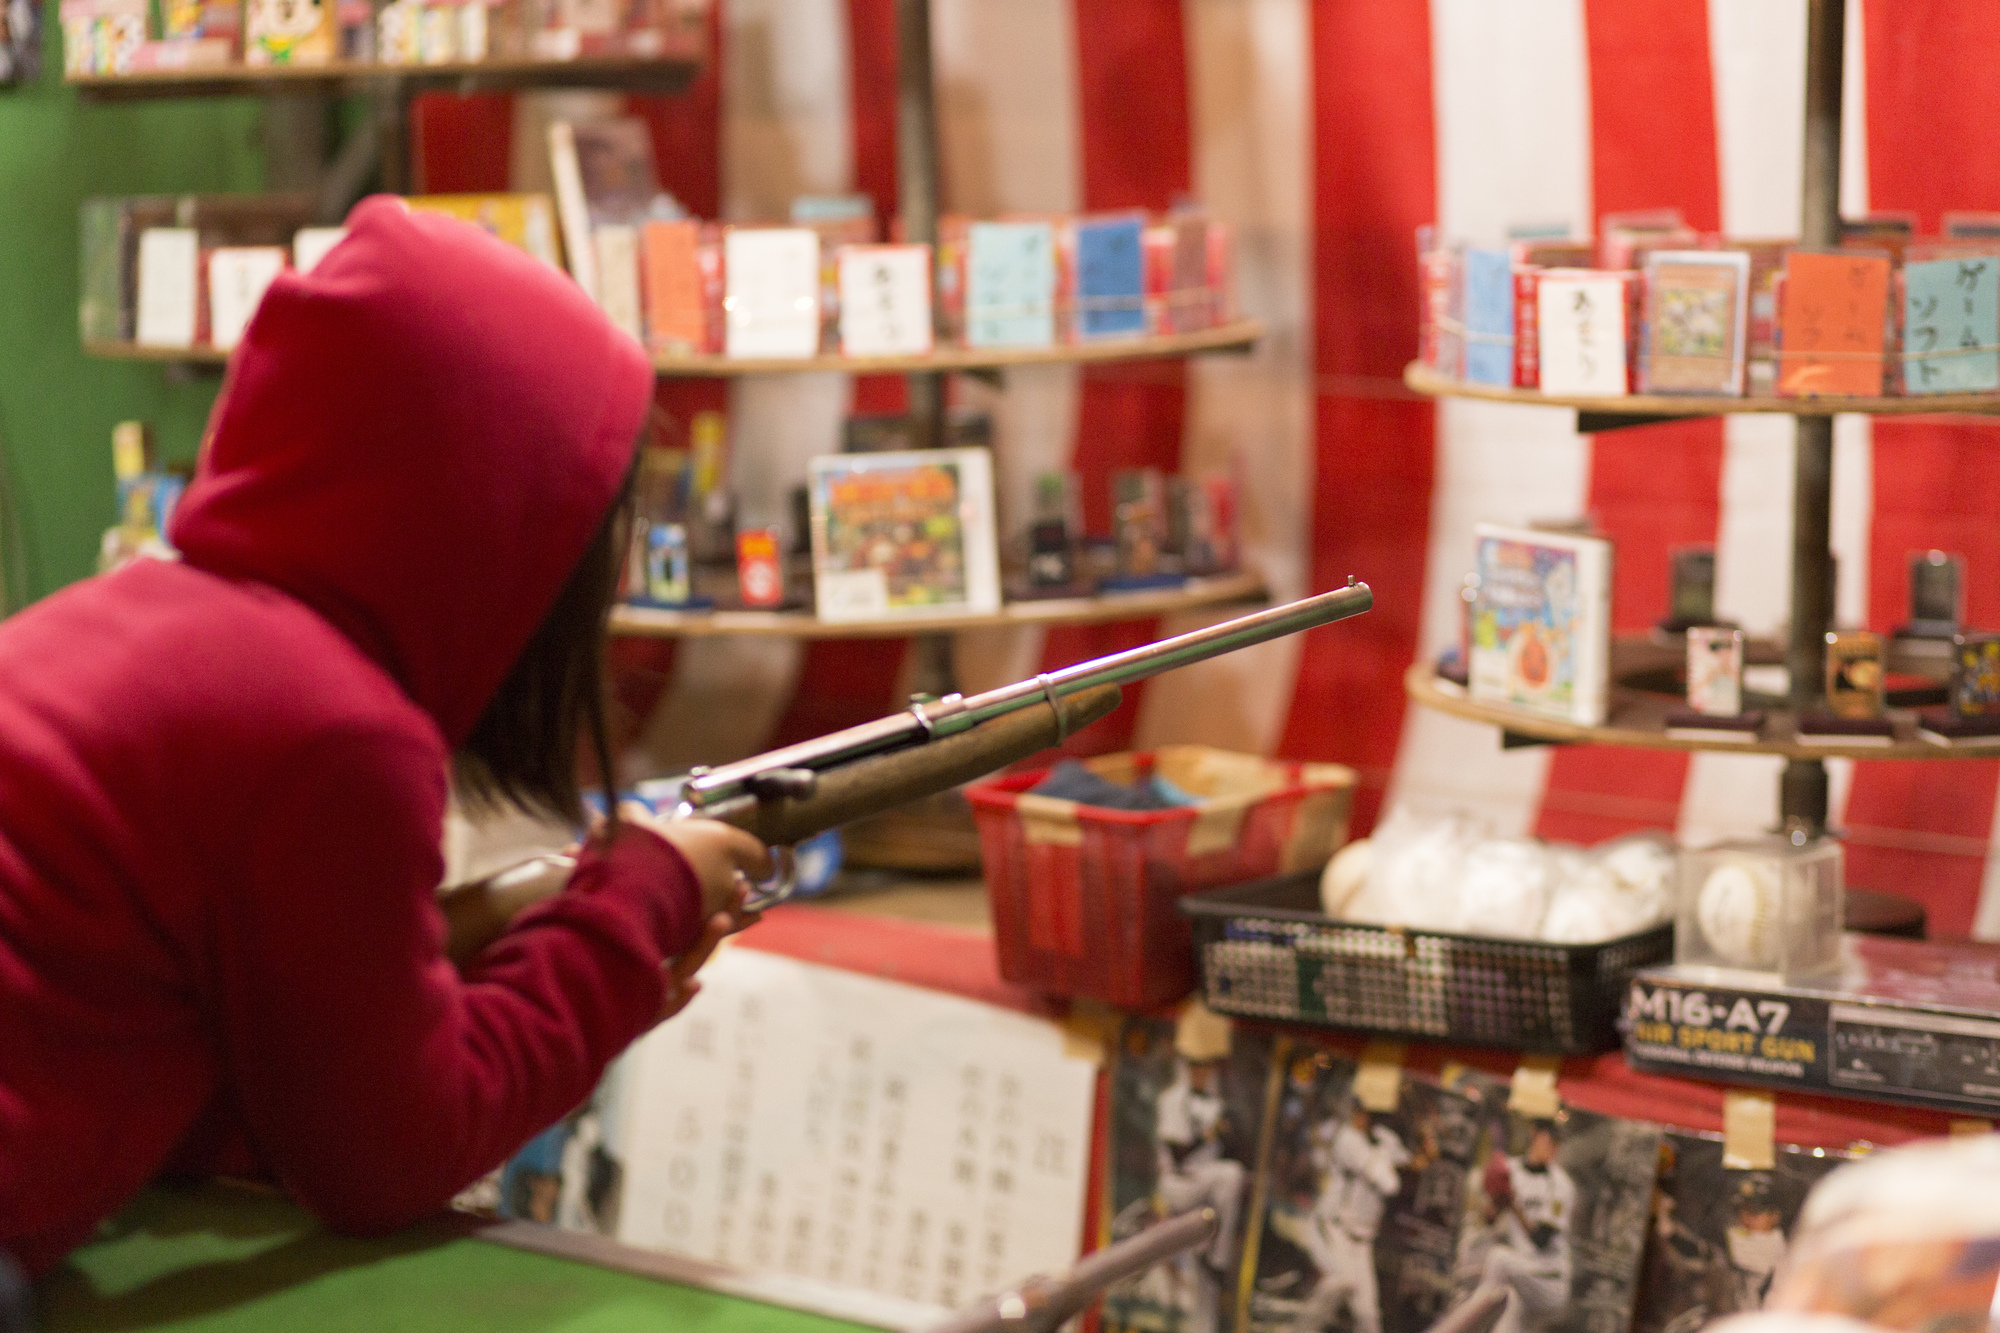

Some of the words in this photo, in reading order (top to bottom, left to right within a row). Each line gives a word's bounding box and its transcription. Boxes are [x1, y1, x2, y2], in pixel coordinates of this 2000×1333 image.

[1911, 295, 1940, 385] ソフト
[1955, 261, 1997, 346] ゲーム
[1678, 1026, 1755, 1053] SPORT
[1761, 1036, 1815, 1062] GUN
